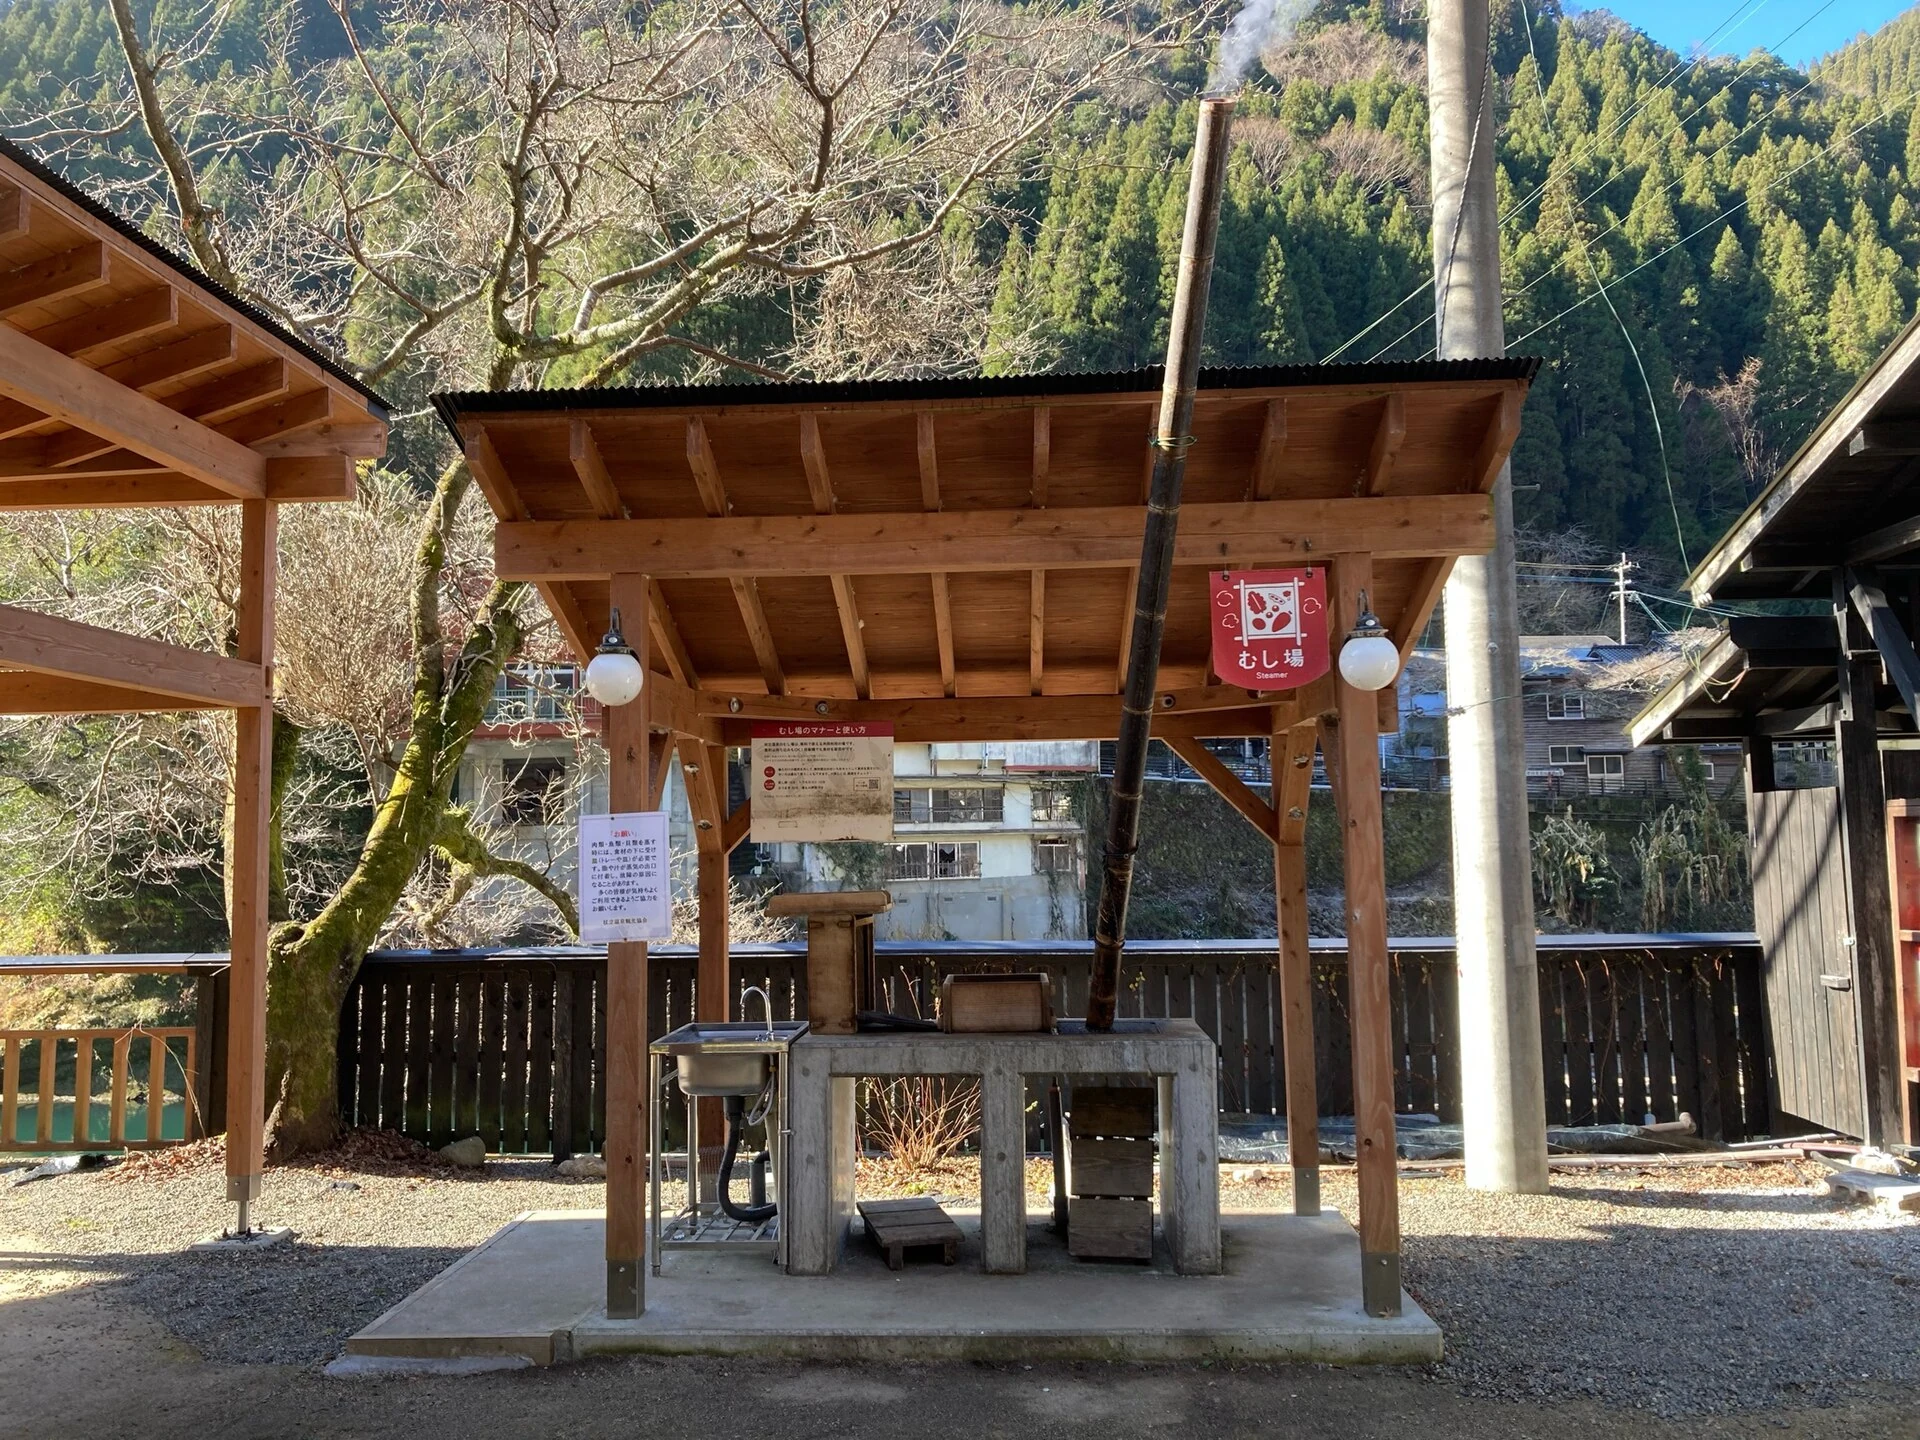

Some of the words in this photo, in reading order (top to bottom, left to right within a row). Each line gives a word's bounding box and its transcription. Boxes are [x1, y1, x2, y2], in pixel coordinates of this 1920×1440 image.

[1238, 648, 1304, 670] むし場
[1256, 671, 1289, 680] Steamer
[778, 725, 866, 735] むし場のマナーと使い方
